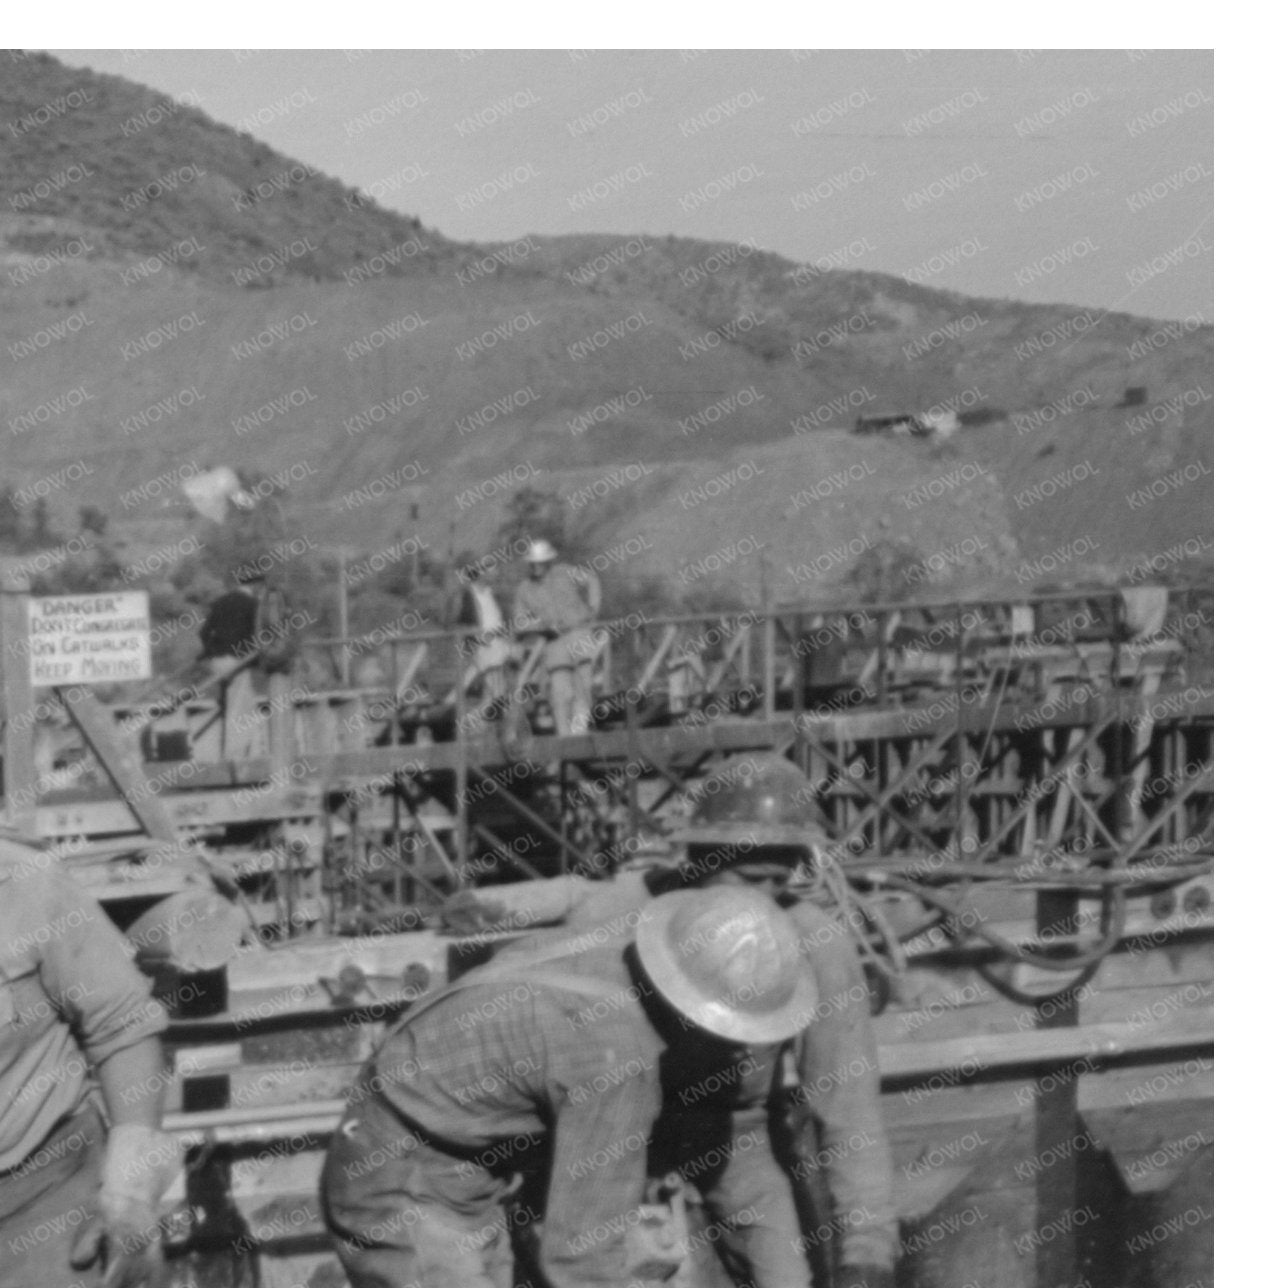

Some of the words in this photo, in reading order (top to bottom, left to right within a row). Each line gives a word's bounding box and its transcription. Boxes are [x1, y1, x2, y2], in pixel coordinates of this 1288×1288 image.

[32, 638, 56, 656] ON
[61, 636, 139, 654] CATWALKS
[82, 657, 140, 676] MOVING
